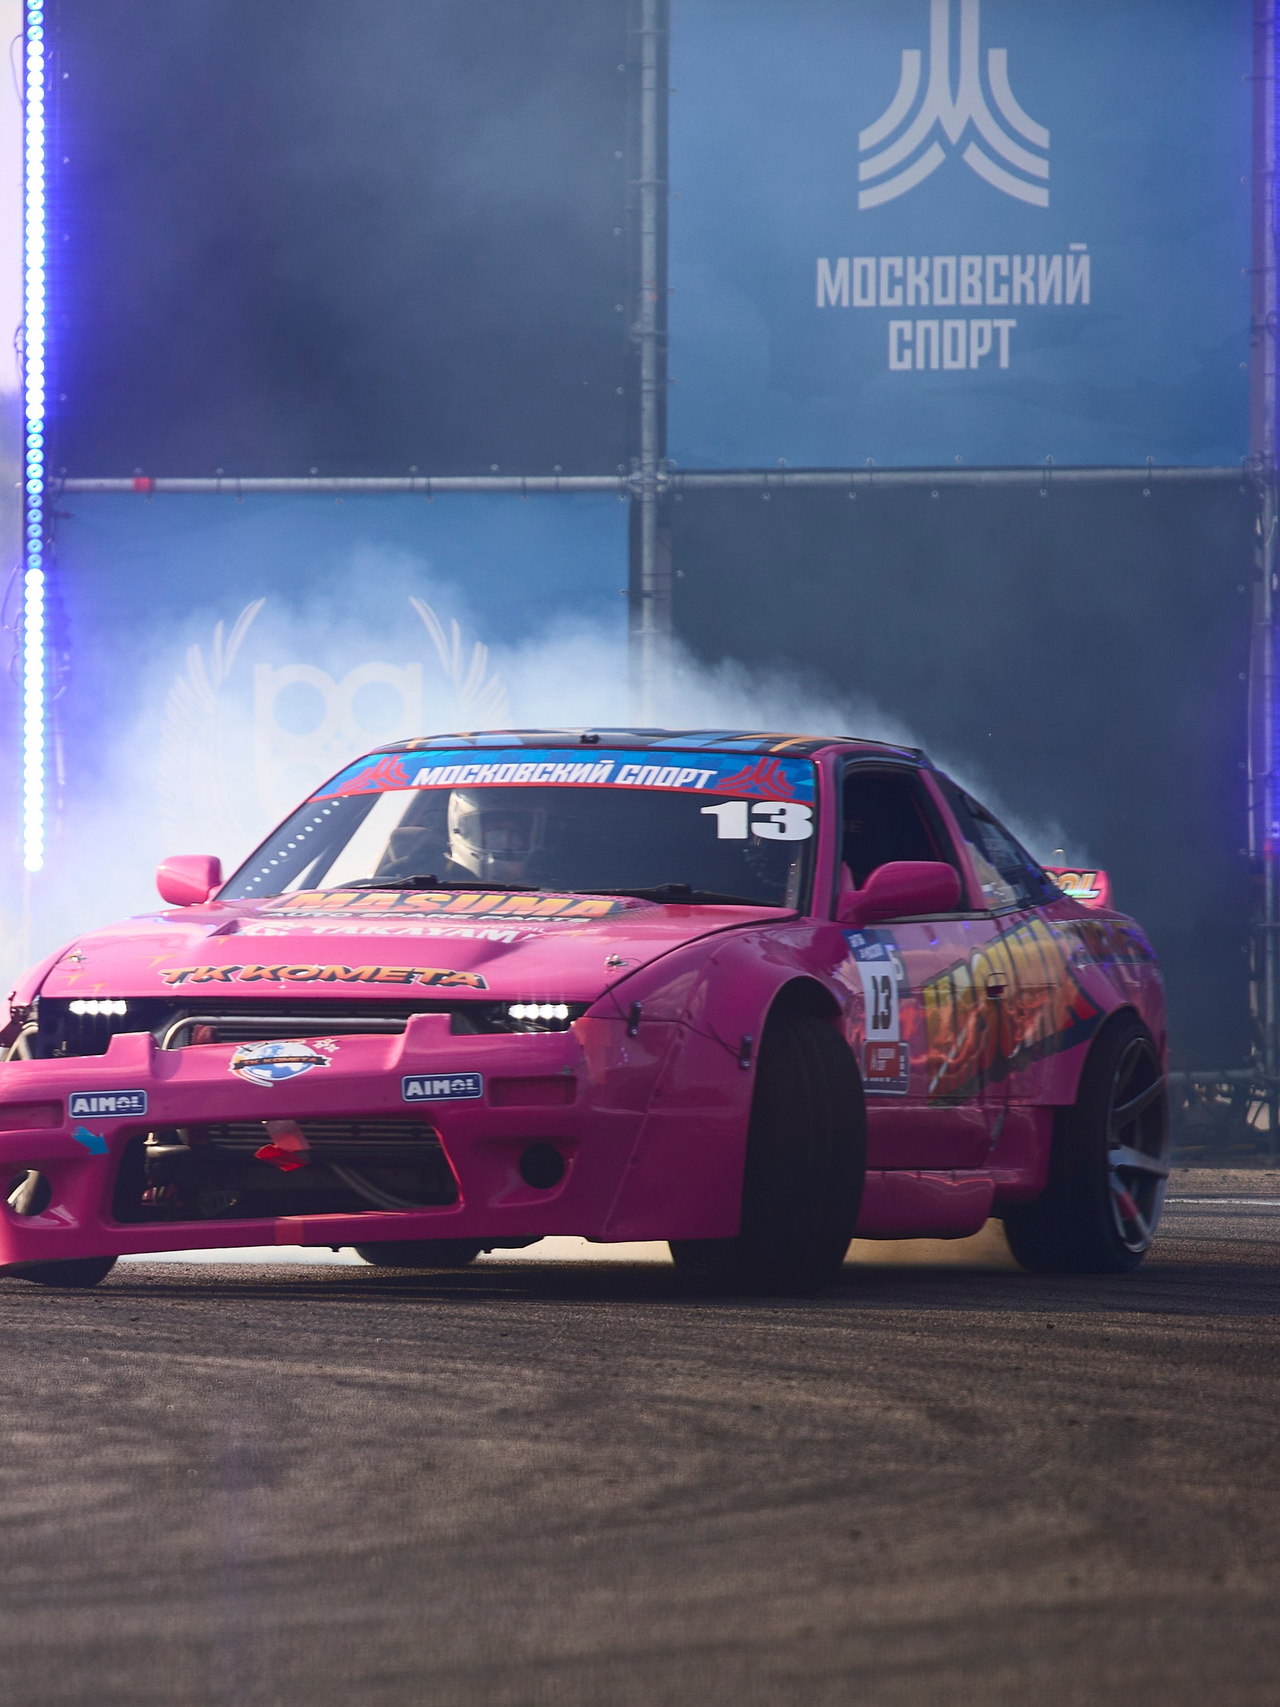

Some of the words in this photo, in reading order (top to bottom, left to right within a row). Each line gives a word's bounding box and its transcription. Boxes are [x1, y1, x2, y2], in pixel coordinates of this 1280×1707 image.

[816, 243, 1090, 308] МОСКОВСКИЙ
[888, 318, 1017, 371] СПОРТ
[411, 759, 616, 786] МОСКОВСКИЙ
[614, 763, 718, 789] СПОРТ
[700, 801, 814, 841] 13
[281, 892, 615, 918] MASUMA
[359, 912, 476, 920] SPARE
[477, 915, 594, 923] PARTS
[159, 962, 234, 986] TK
[237, 962, 489, 990] KOMETA
[871, 975, 893, 1030] 13
[406, 1078, 479, 1098] AIMOL
[72, 1094, 144, 1114] AIMOL
